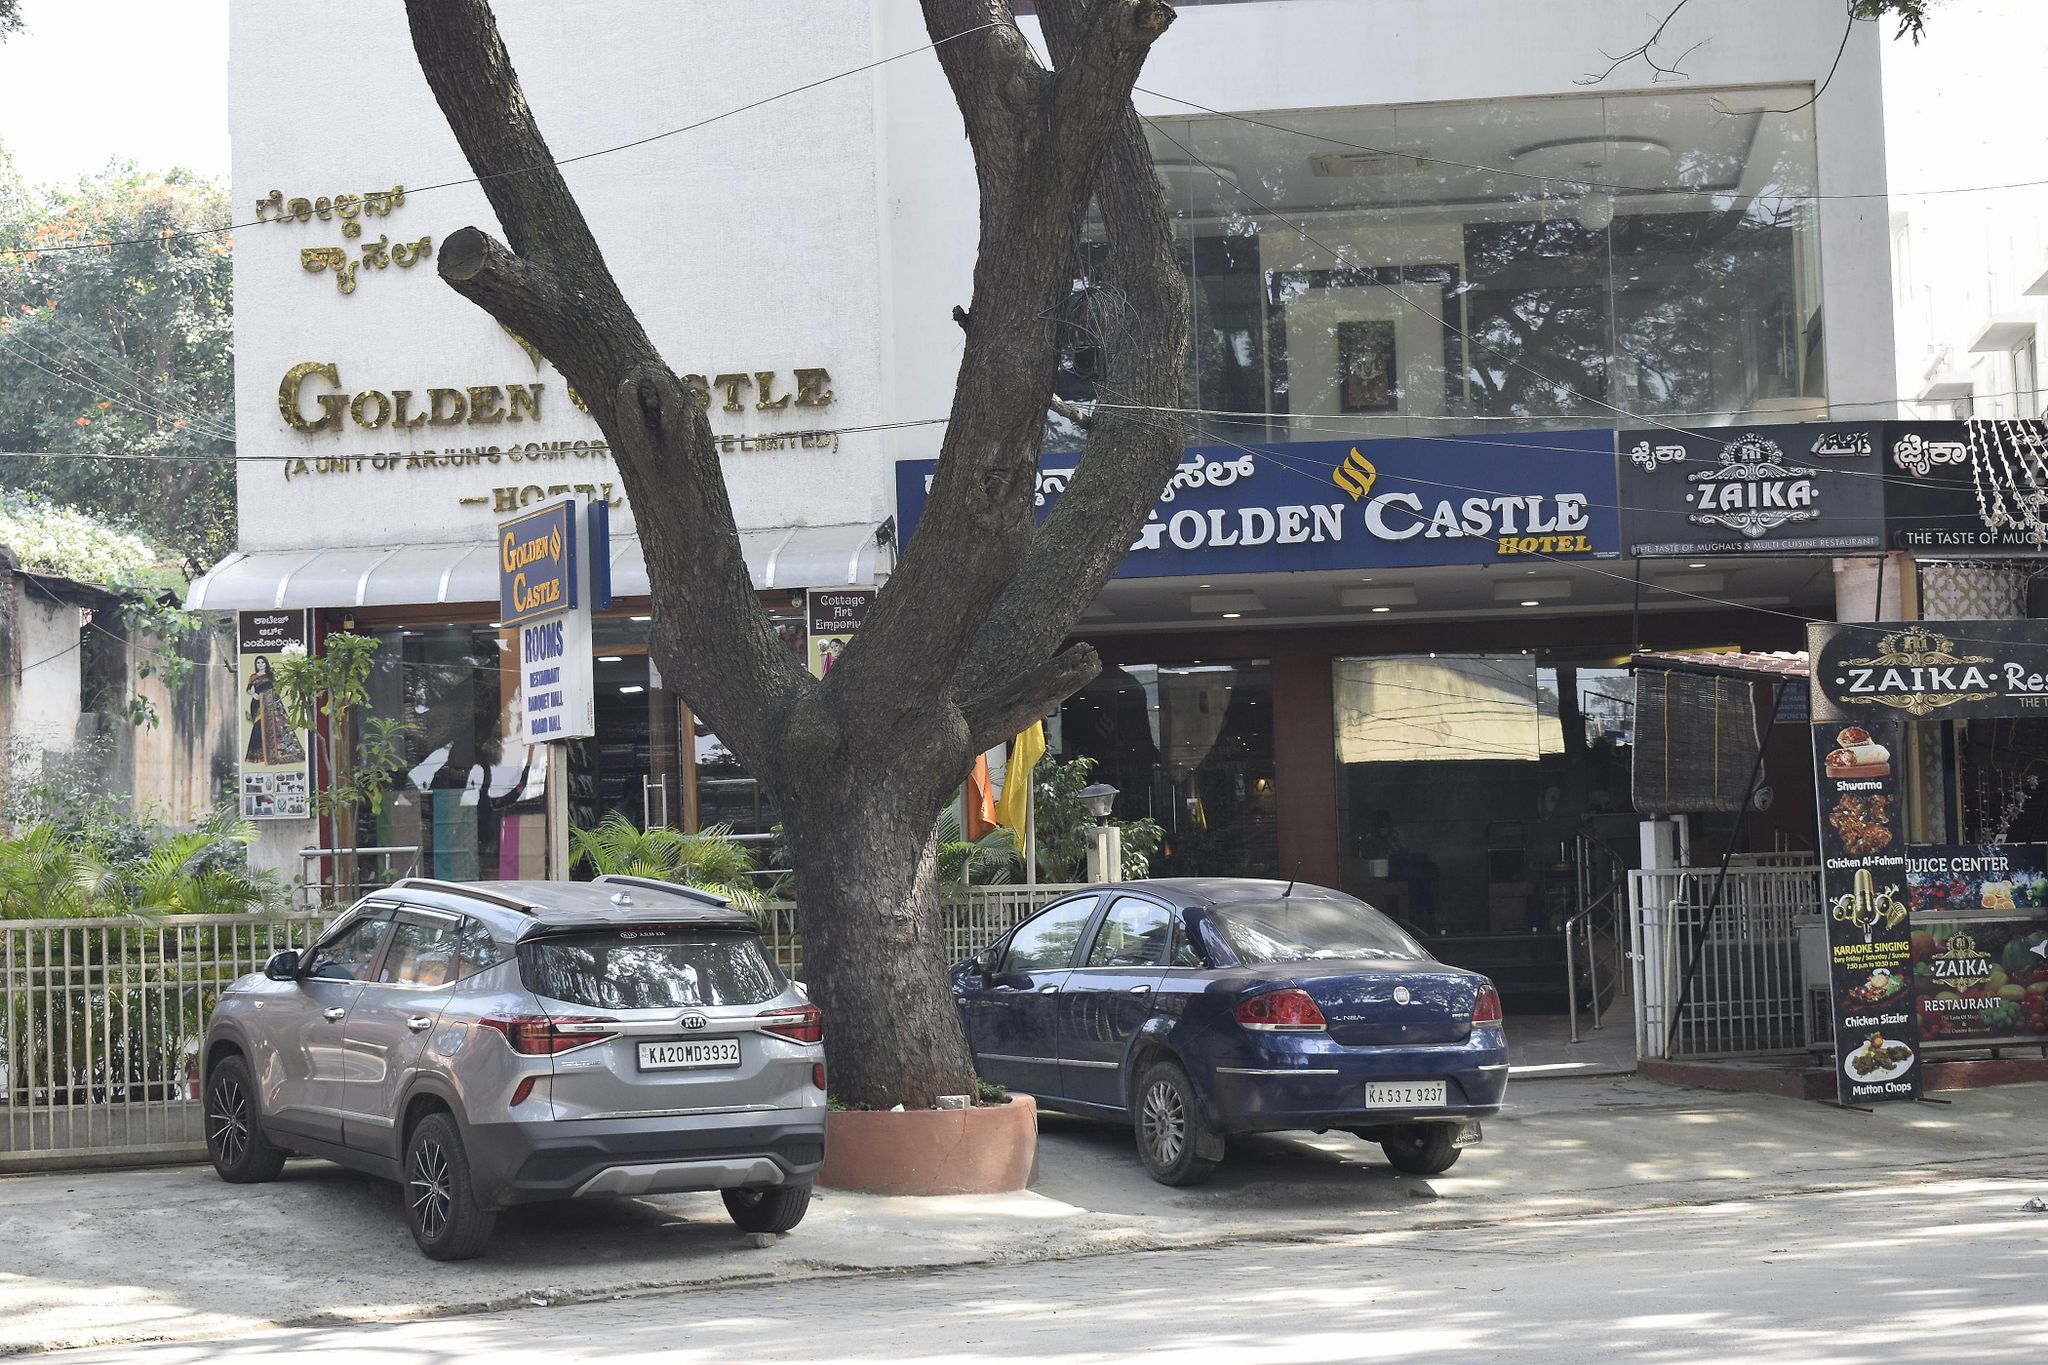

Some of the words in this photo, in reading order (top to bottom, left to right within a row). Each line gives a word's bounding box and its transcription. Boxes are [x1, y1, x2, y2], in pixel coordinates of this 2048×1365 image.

[278, 361, 545, 433] GOLDEN
[315, 453, 362, 474] UNIT
[371, 451, 401, 470] OF
[508, 439, 608, 462] COMFOR
[1697, 480, 1811, 511] ZAIKA
[1364, 493, 1590, 540] CASTLE
[1497, 535, 1592, 554] HOTEL
[1637, 544, 1652, 553] THE
[1655, 543, 1679, 552] TASTE
[1681, 543, 1694, 552] OF
[1696, 542, 1742, 551] MUGHAL'S
[1744, 542, 1751, 550] &
[1753, 541, 1779, 549] MULTI
[1782, 539, 1817, 548] CUISINE
[1820, 537, 1875, 547] RESTAURANT
[1907, 532, 1932, 544] THE
[1938, 532, 1975, 544] TASTE
[1979, 532, 1999, 544] OF
[503, 531, 549, 573] GOLDEN
[513, 572, 560, 612] CASTLE
[821, 595, 865, 606] Cottage
[834, 607, 853, 619] Art
[816, 618, 861, 631] Emporiu
[525, 620, 564, 663] ROOMS
[1849, 666, 1989, 692] ZAIKA
[2019, 697, 2040, 708] THE
[1836, 780, 1882, 791] Shwarma
[1827, 858, 1860, 869] Chicken
[1862, 856, 1904, 867] Al-Faham
[1905, 858, 1948, 873] JUICE
[1951, 857, 2009, 872] CENTER
[1834, 944, 1873, 956] KARAOKE
[1874, 941, 1909, 953] SINGING
[1866, 953, 1887, 961] Saturday
[1935, 959, 1989, 977] ZAIKA
[1924, 997, 2002, 1012] RESTAURANT
[684, 1016, 705, 1029] KIA
[1845, 1016, 1879, 1027] Chicken
[1880, 1013, 1908, 1024] Sizzler
[649, 1044, 738, 1064] KA20MD3932
[1405, 1089, 1412, 1103] Z
[1417, 1088, 1443, 1101] 9237
[1852, 1085, 1883, 1096] Mutton
[1885, 1082, 1912, 1093] Chops
